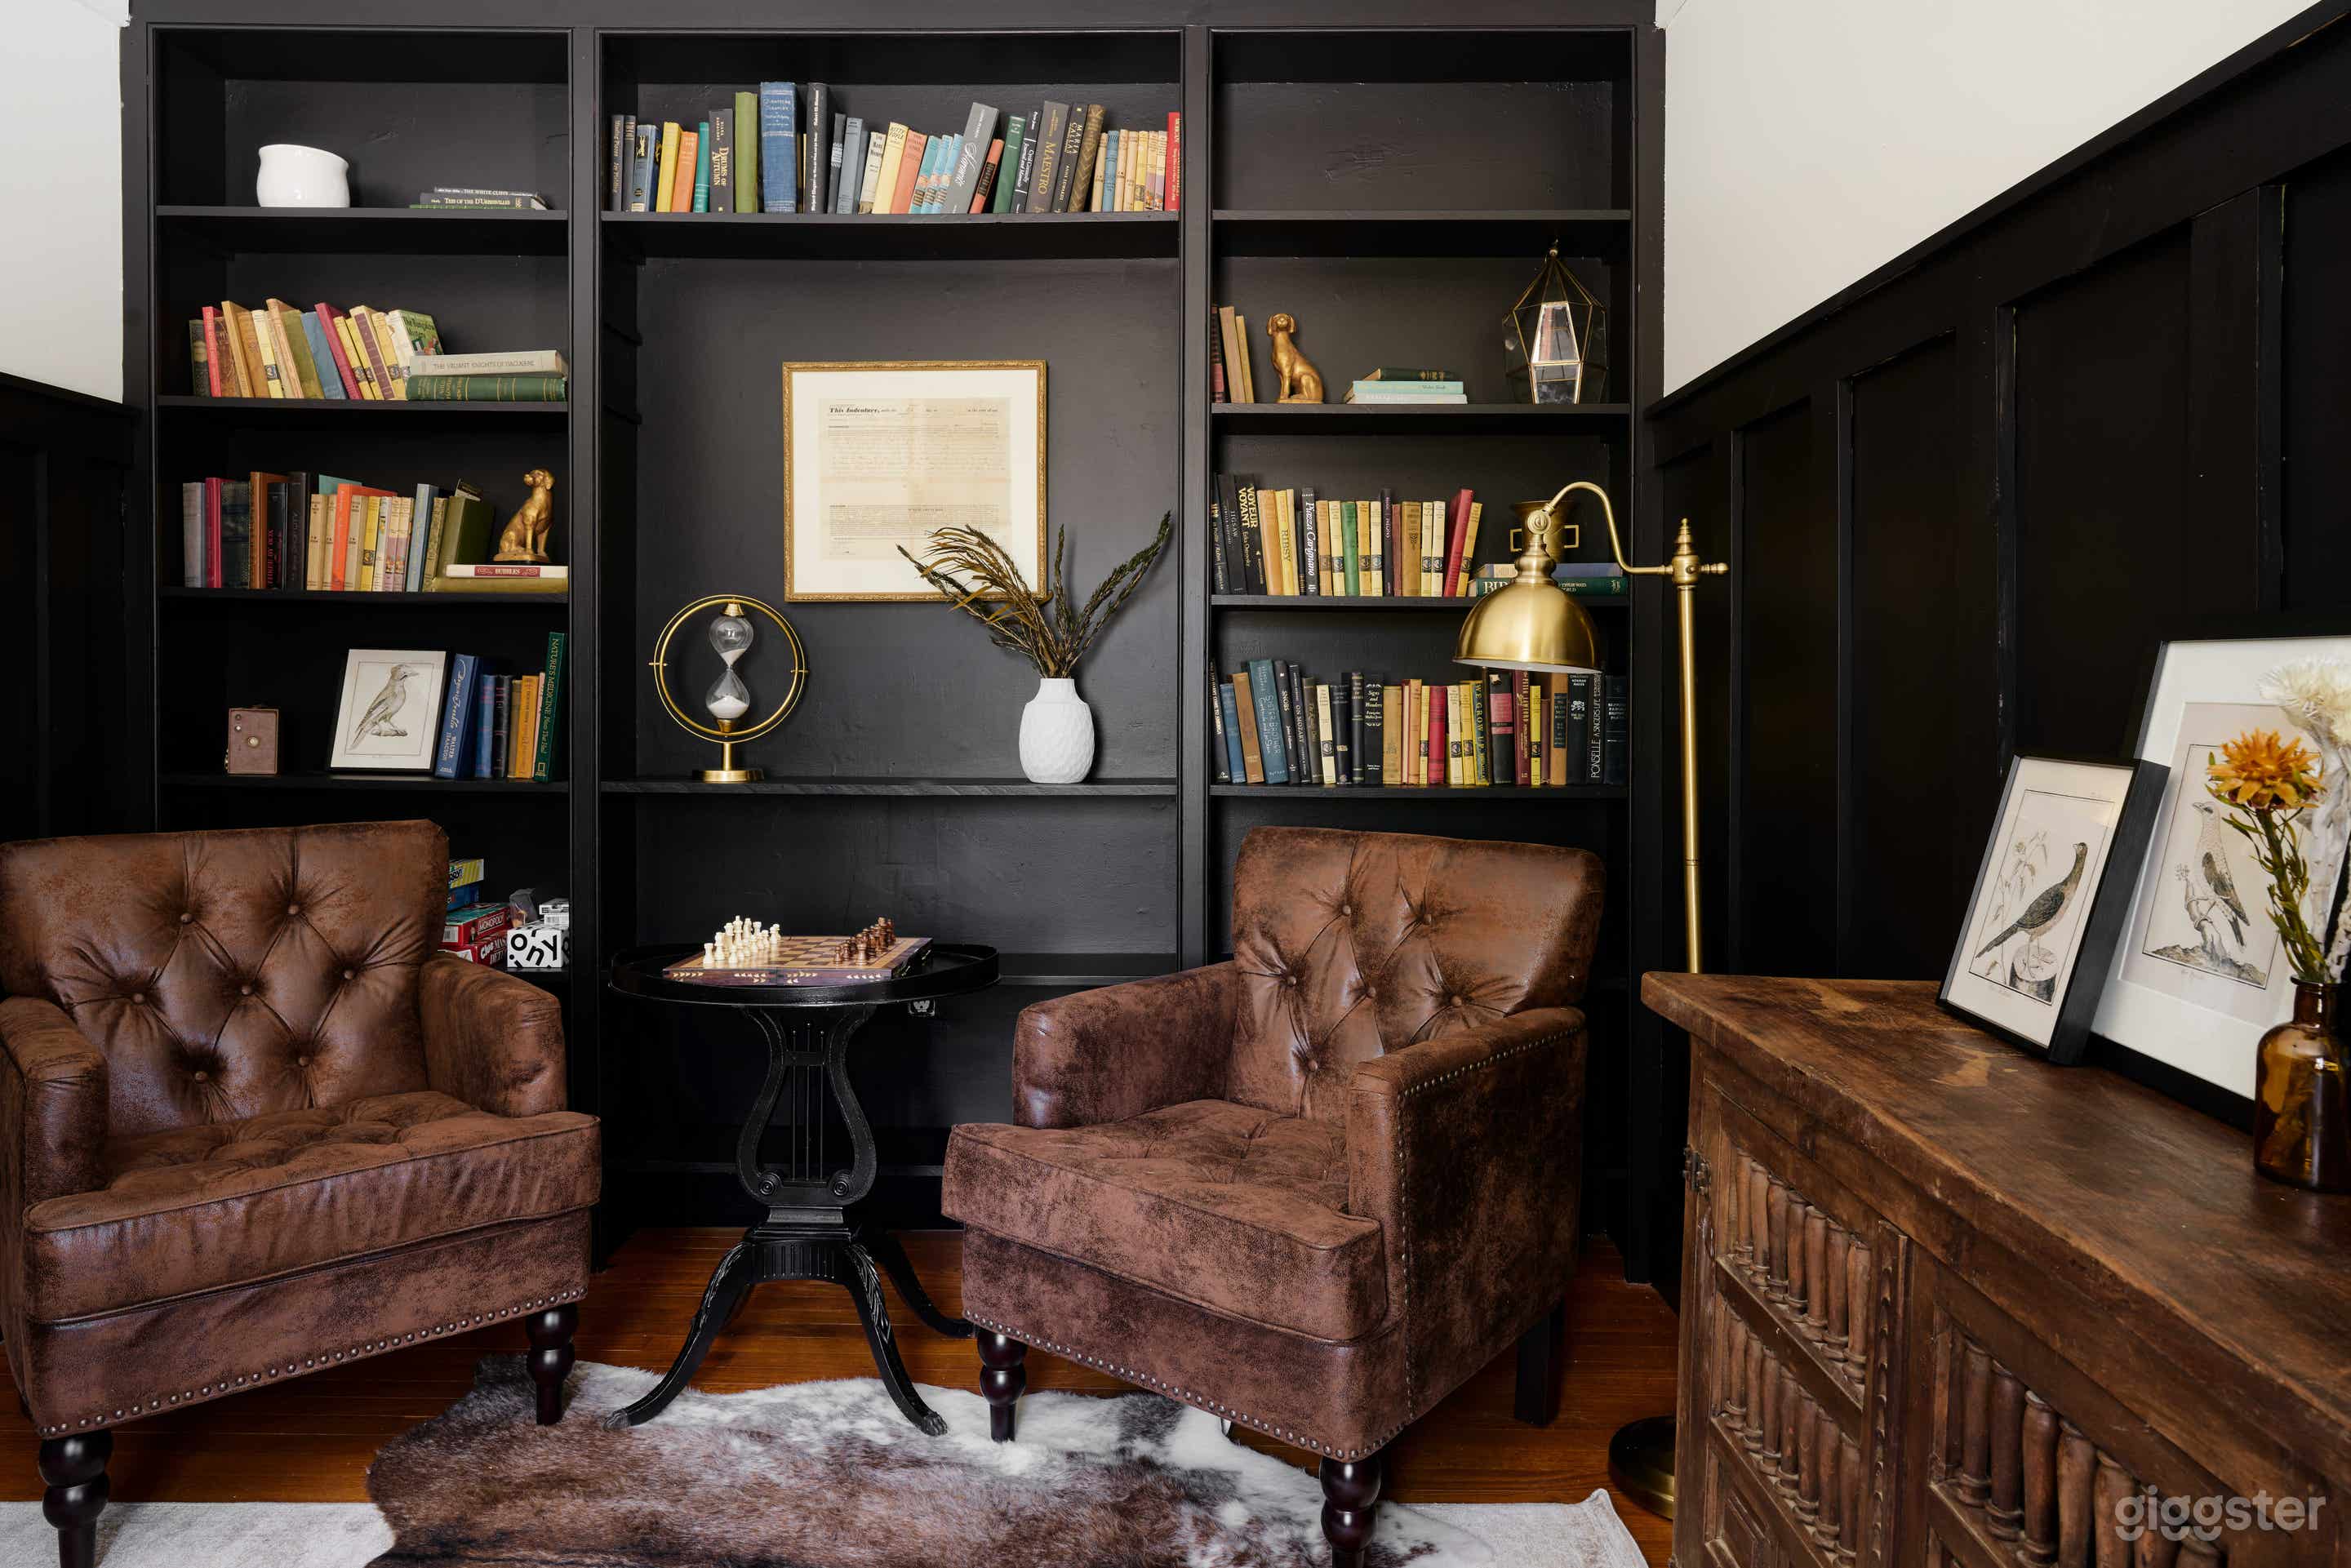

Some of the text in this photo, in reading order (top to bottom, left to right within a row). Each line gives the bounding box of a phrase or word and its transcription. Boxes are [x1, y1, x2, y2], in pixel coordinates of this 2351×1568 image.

[1067, 122, 1077, 154] CALLAS
[1073, 124, 1082, 154] MARIA
[712, 152, 721, 186] AUTUMN
[718, 147, 729, 187] DRUMS OF
[1038, 141, 1057, 195] MAESTRO
[1238, 487, 1250, 529] VOYANT
[1247, 486, 1258, 529] VOYEUR
[1230, 510, 1238, 538] JIGSAW
[1304, 502, 1316, 576] Piazza Carignano
[1281, 529, 1291, 562] RIBSY
[544, 676, 554, 715] MEDICINE
[1282, 690, 1290, 712] SNOBS
[1475, 684, 1482, 699] WE
[1264, 694, 1281, 754] SISTER BROTHER
[1295, 704, 1302, 715] ON
[1296, 716, 1304, 744] MOZART
[1477, 736, 1484, 749] UP
[1590, 739, 1600, 778] PONSELLE
[479, 913, 503, 932] MONOPOLY
[481, 942, 494, 959] Clue
